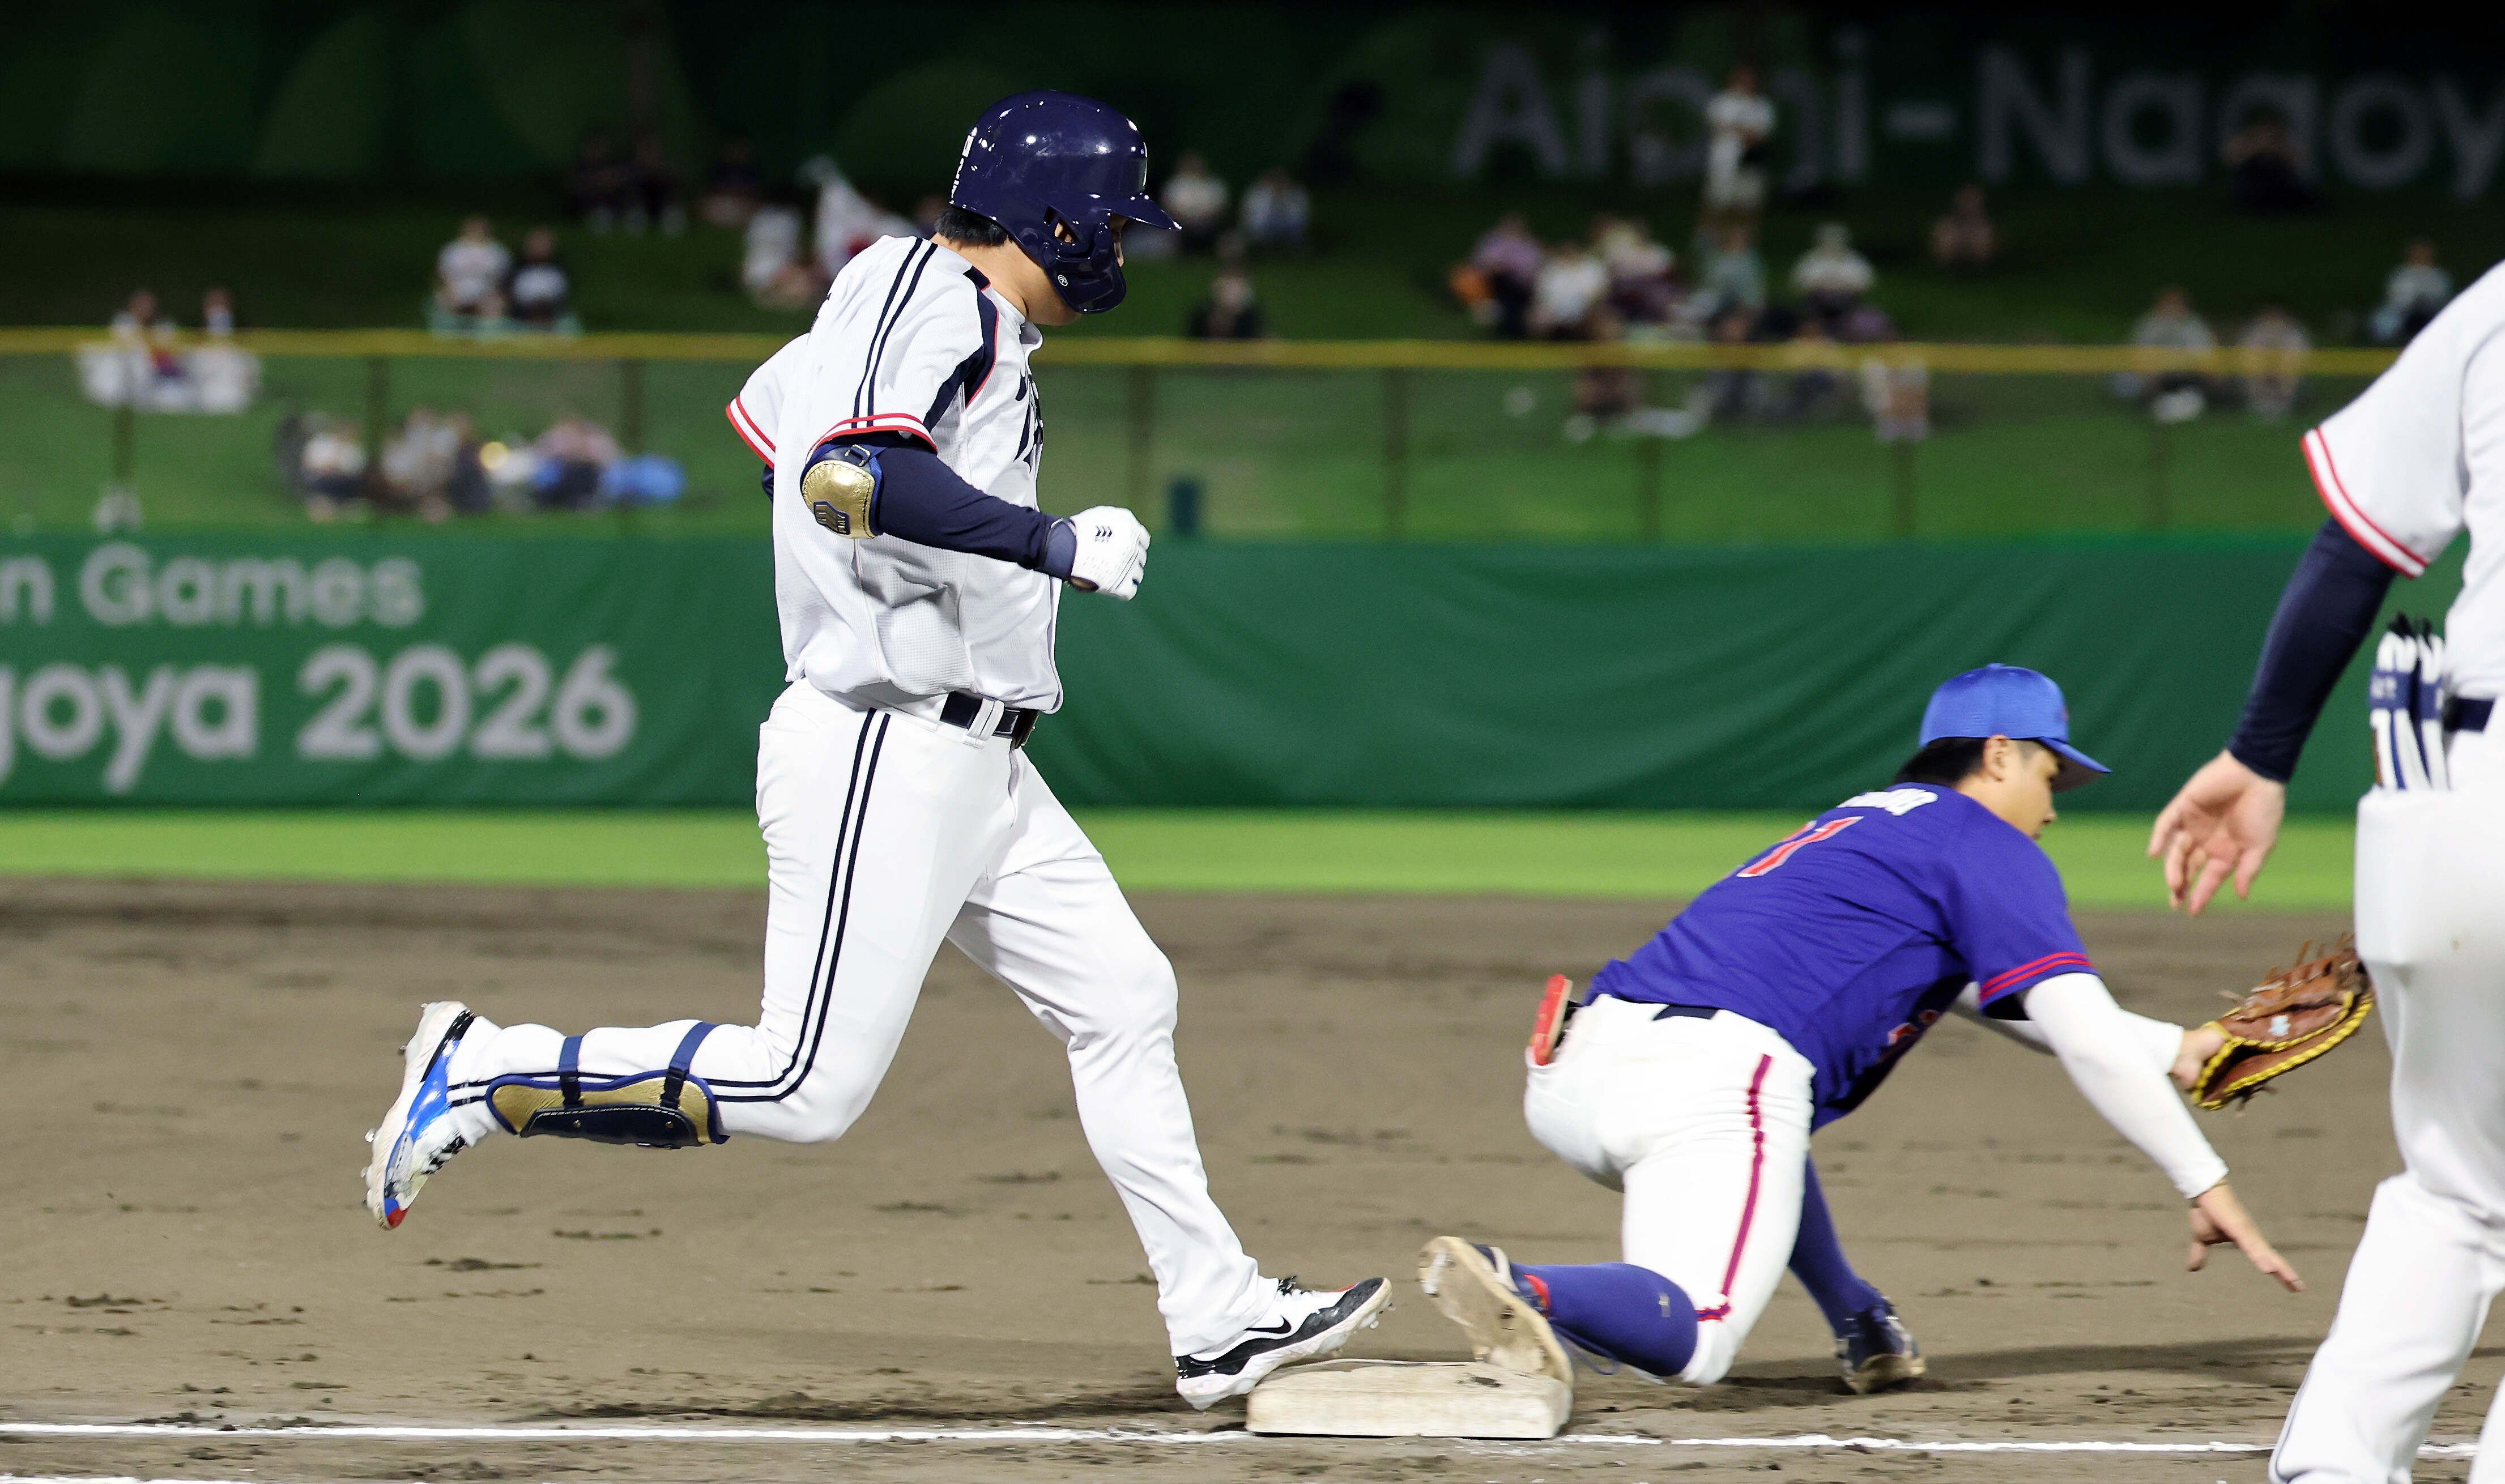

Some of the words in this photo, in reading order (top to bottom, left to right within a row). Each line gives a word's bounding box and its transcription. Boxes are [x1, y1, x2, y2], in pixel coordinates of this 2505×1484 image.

[80, 542, 424, 626] Games
[0, 663, 258, 794] oya
[297, 643, 638, 760] 2026
